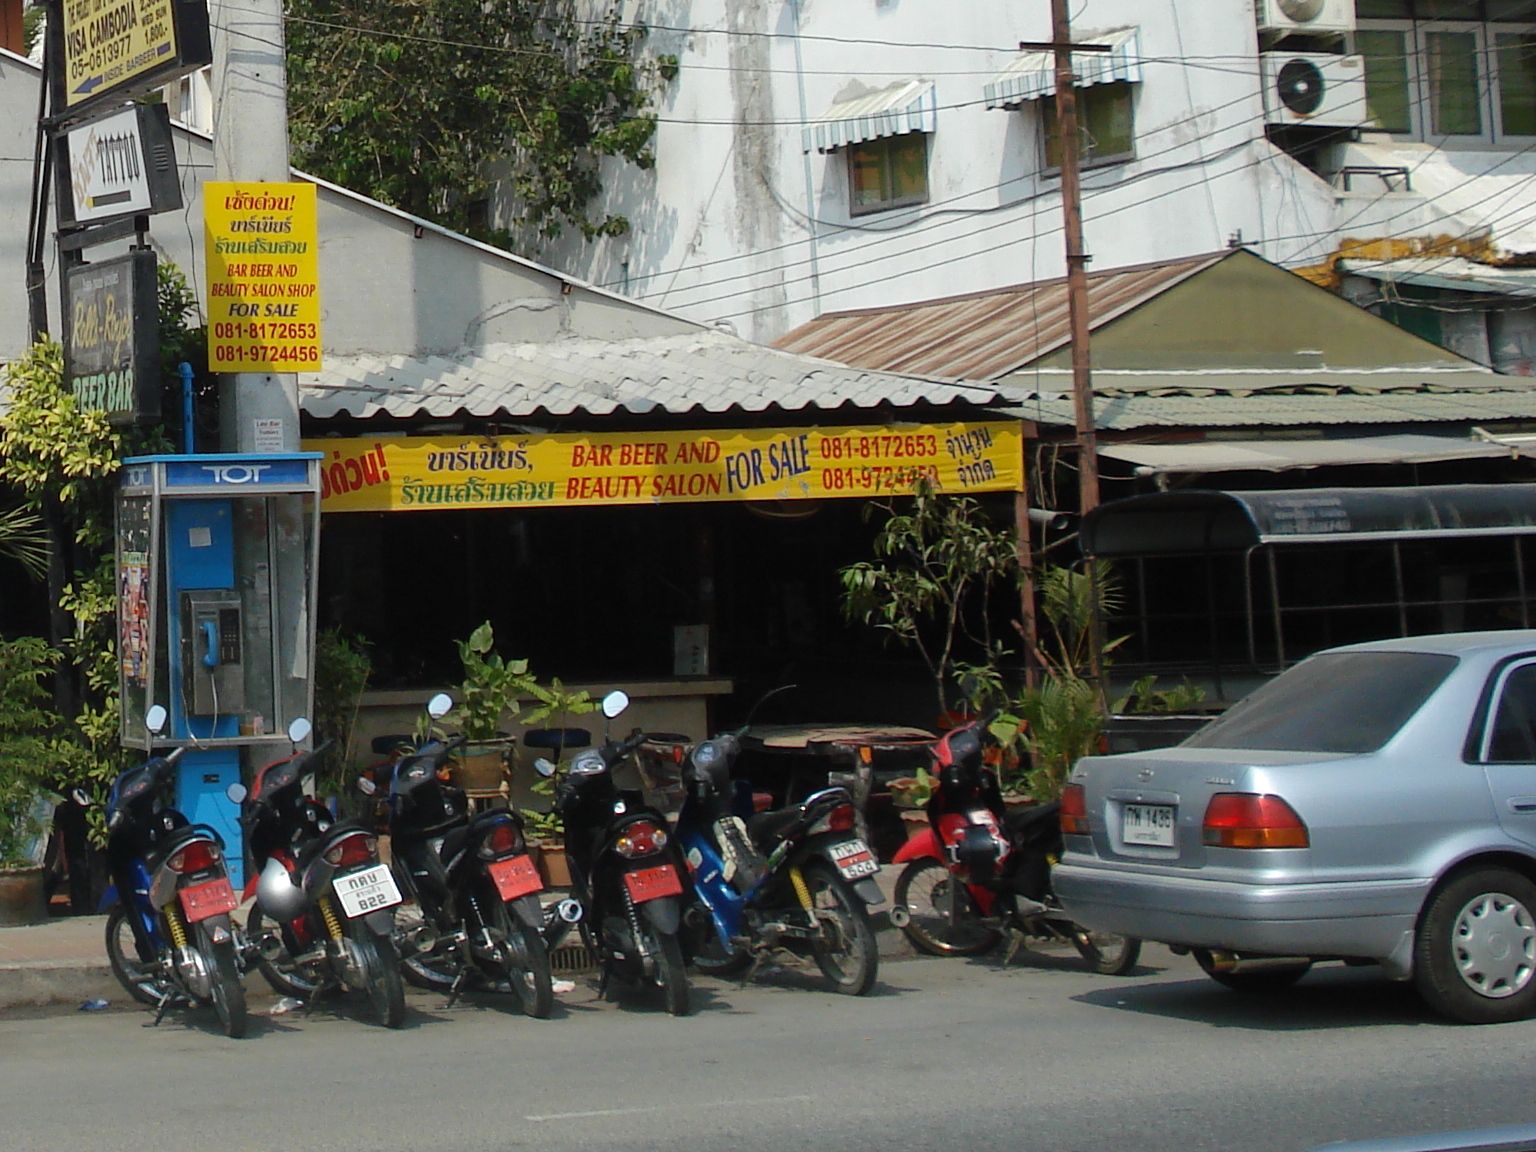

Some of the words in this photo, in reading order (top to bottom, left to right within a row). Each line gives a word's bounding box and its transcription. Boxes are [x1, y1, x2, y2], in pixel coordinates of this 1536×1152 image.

[141, 14, 154, 28] WED
[155, 5, 167, 22] SUN
[67, 26, 88, 60] VISA
[89, 0, 137, 49] CAMBODIA
[71, 34, 132, 79] 05-0613977
[104, 63, 123, 83] INSIDE
[97, 130, 140, 185] TATTOO
[227, 264, 247, 277] BAR
[250, 264, 274, 277] BEER
[276, 264, 297, 277] AND
[212, 283, 249, 297] BEAUTY
[252, 283, 285, 297] SALON
[287, 284, 316, 297] SHOP
[229, 303, 260, 317] FOR
[264, 303, 299, 317] SALE
[215, 323, 316, 339] 081-8172653
[216, 345, 318, 362] 081-9724456
[107, 368, 133, 413] BAR
[571, 445, 612, 467] BAR
[619, 443, 667, 466] BEER
[674, 441, 721, 464] AND
[821, 435, 937, 459] 081-8172653
[202, 465, 271, 483] TOT
[725, 448, 765, 493] FOR
[769, 435, 811, 481] SALE
[401, 476, 555, 504] ร้านเสริมสวย
[566, 475, 647, 499] BEAUTY
[651, 473, 723, 497] SALON
[1147, 809, 1171, 828] 1436
[358, 893, 388, 911] 822
